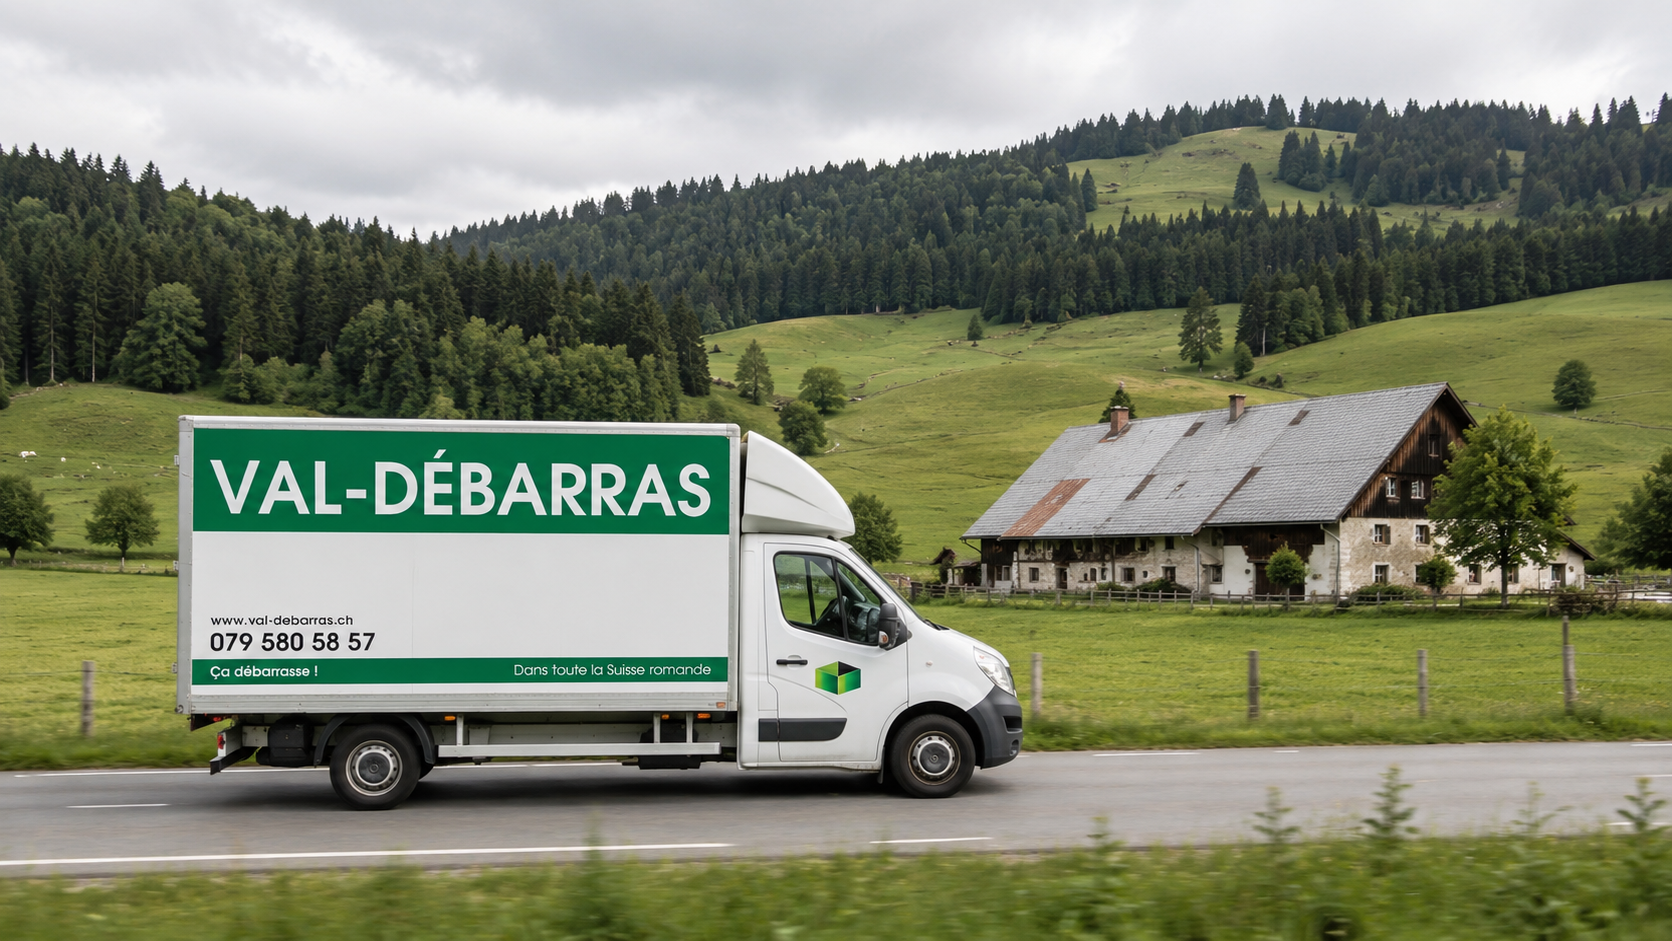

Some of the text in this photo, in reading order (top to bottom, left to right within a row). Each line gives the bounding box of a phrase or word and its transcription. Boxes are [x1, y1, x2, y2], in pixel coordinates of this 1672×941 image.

[210, 448, 711, 518] VAL-DÉBARRAS
[210, 615, 354, 626] www.val-debarras.ch
[210, 632, 376, 651] 079 580 58 57
[210, 665, 318, 680] Ça débarrasse !
[514, 663, 711, 676] Dans toute la Suisse romande
